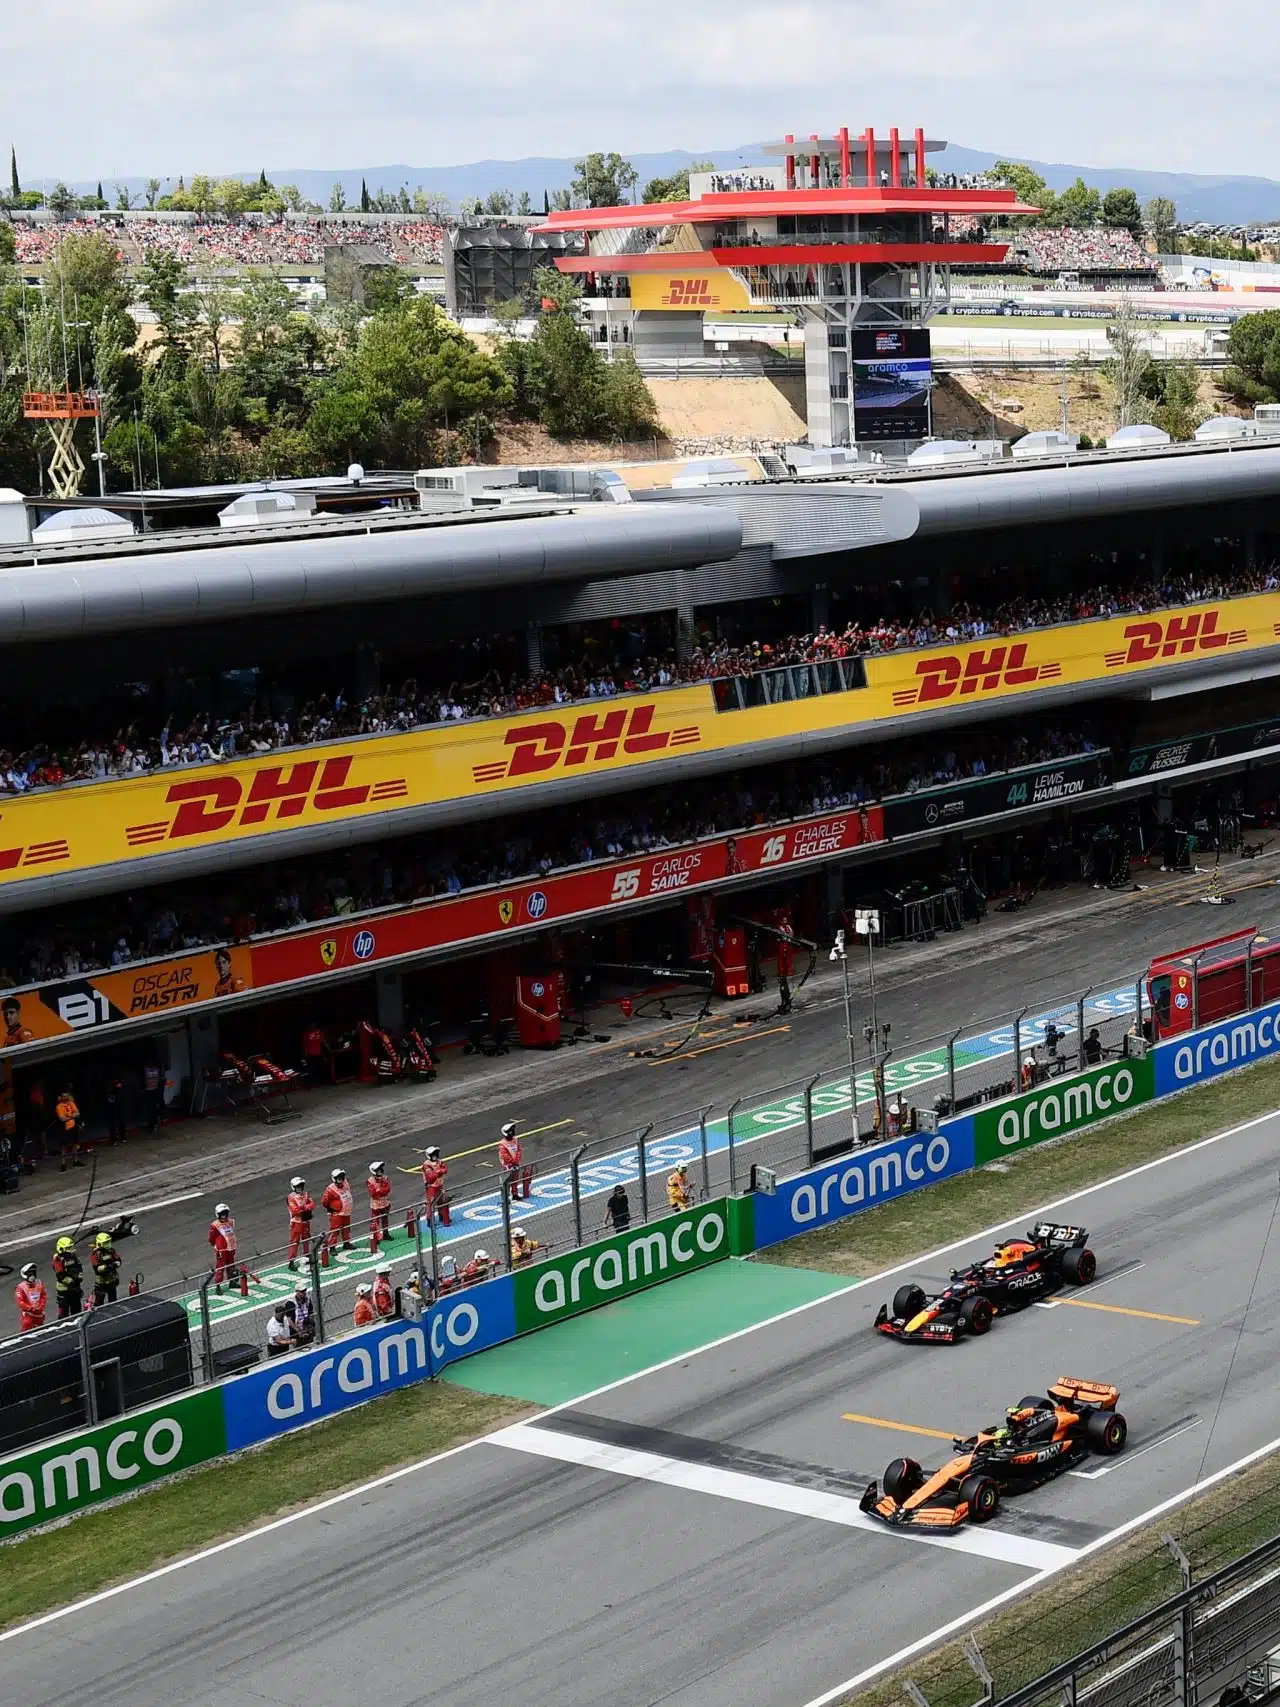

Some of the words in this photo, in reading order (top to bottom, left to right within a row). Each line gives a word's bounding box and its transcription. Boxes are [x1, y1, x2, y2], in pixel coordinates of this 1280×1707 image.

[669, 279, 712, 305] DHL
[1105, 284, 1127, 292] QATAR
[1128, 284, 1154, 292] AIRWAYS
[955, 307, 997, 316] crypto.com
[1013, 308, 1056, 317] crypto.com
[1187, 314, 1230, 323] crypto.com
[867, 363, 909, 373] aramco
[1123, 611, 1230, 664] DHL
[915, 643, 1041, 703] DHL
[504, 704, 672, 777] DHL
[1155, 743, 1193, 760] GEORGE
[1128, 754, 1149, 773] 63
[1149, 753, 1188, 771] RUSSELL
[1032, 779, 1085, 802] HAMILTON
[1034, 771, 1065, 789] LEWIS
[164, 755, 372, 839] DHL
[1007, 782, 1028, 805] 44
[794, 819, 847, 844] CHARLES
[759, 835, 787, 865] 16
[791, 835, 843, 859] LECLERC
[652, 852, 702, 876] CARLOS
[611, 868, 642, 900] 55
[650, 870, 690, 892] SAINZ
[528, 892, 545, 918] hp
[356, 931, 374, 958] hp
[132, 966, 193, 995] OSCAR
[533, 982, 545, 996] hp
[130, 982, 200, 1014] PIASTRI
[1175, 994, 1188, 1009] hp
[997, 1068, 1133, 1146] aramco
[791, 1135, 950, 1223] aramco
[535, 1211, 725, 1313] aramco
[1007, 1271, 1044, 1291] ORACLE
[266, 1302, 480, 1420] aramco
